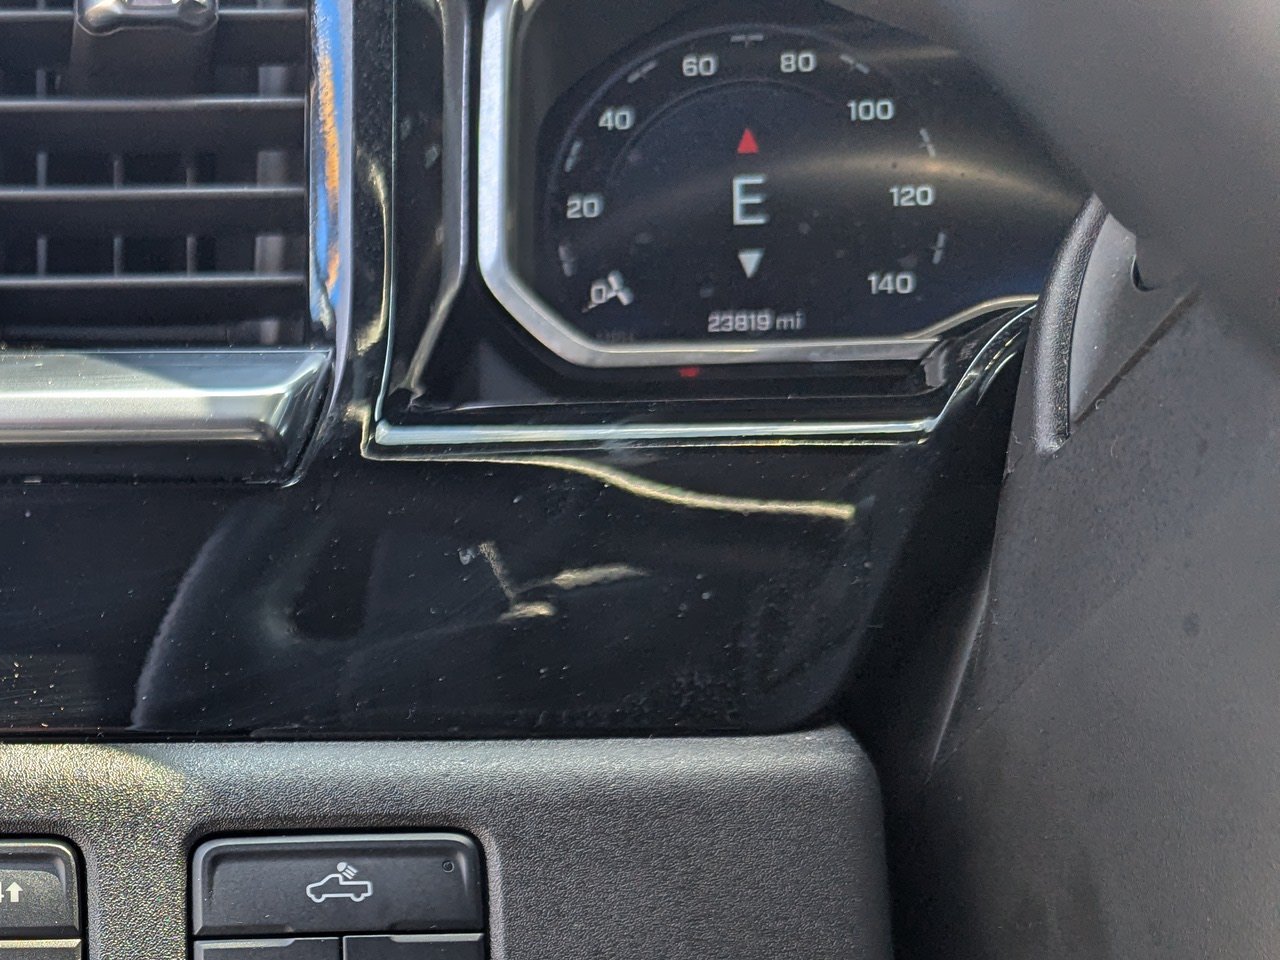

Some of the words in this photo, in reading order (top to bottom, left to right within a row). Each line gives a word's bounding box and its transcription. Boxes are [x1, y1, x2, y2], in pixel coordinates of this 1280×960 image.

[682, 54, 716, 76] 60
[780, 52, 816, 73] 80
[598, 109, 634, 130] 40
[848, 99, 894, 121] 100
[732, 175, 767, 225] E
[890, 186, 933, 207] 120
[566, 199, 601, 219] 20
[868, 272, 913, 295] 140
[707, 309, 772, 332] 23819
[775, 309, 804, 330] mi
